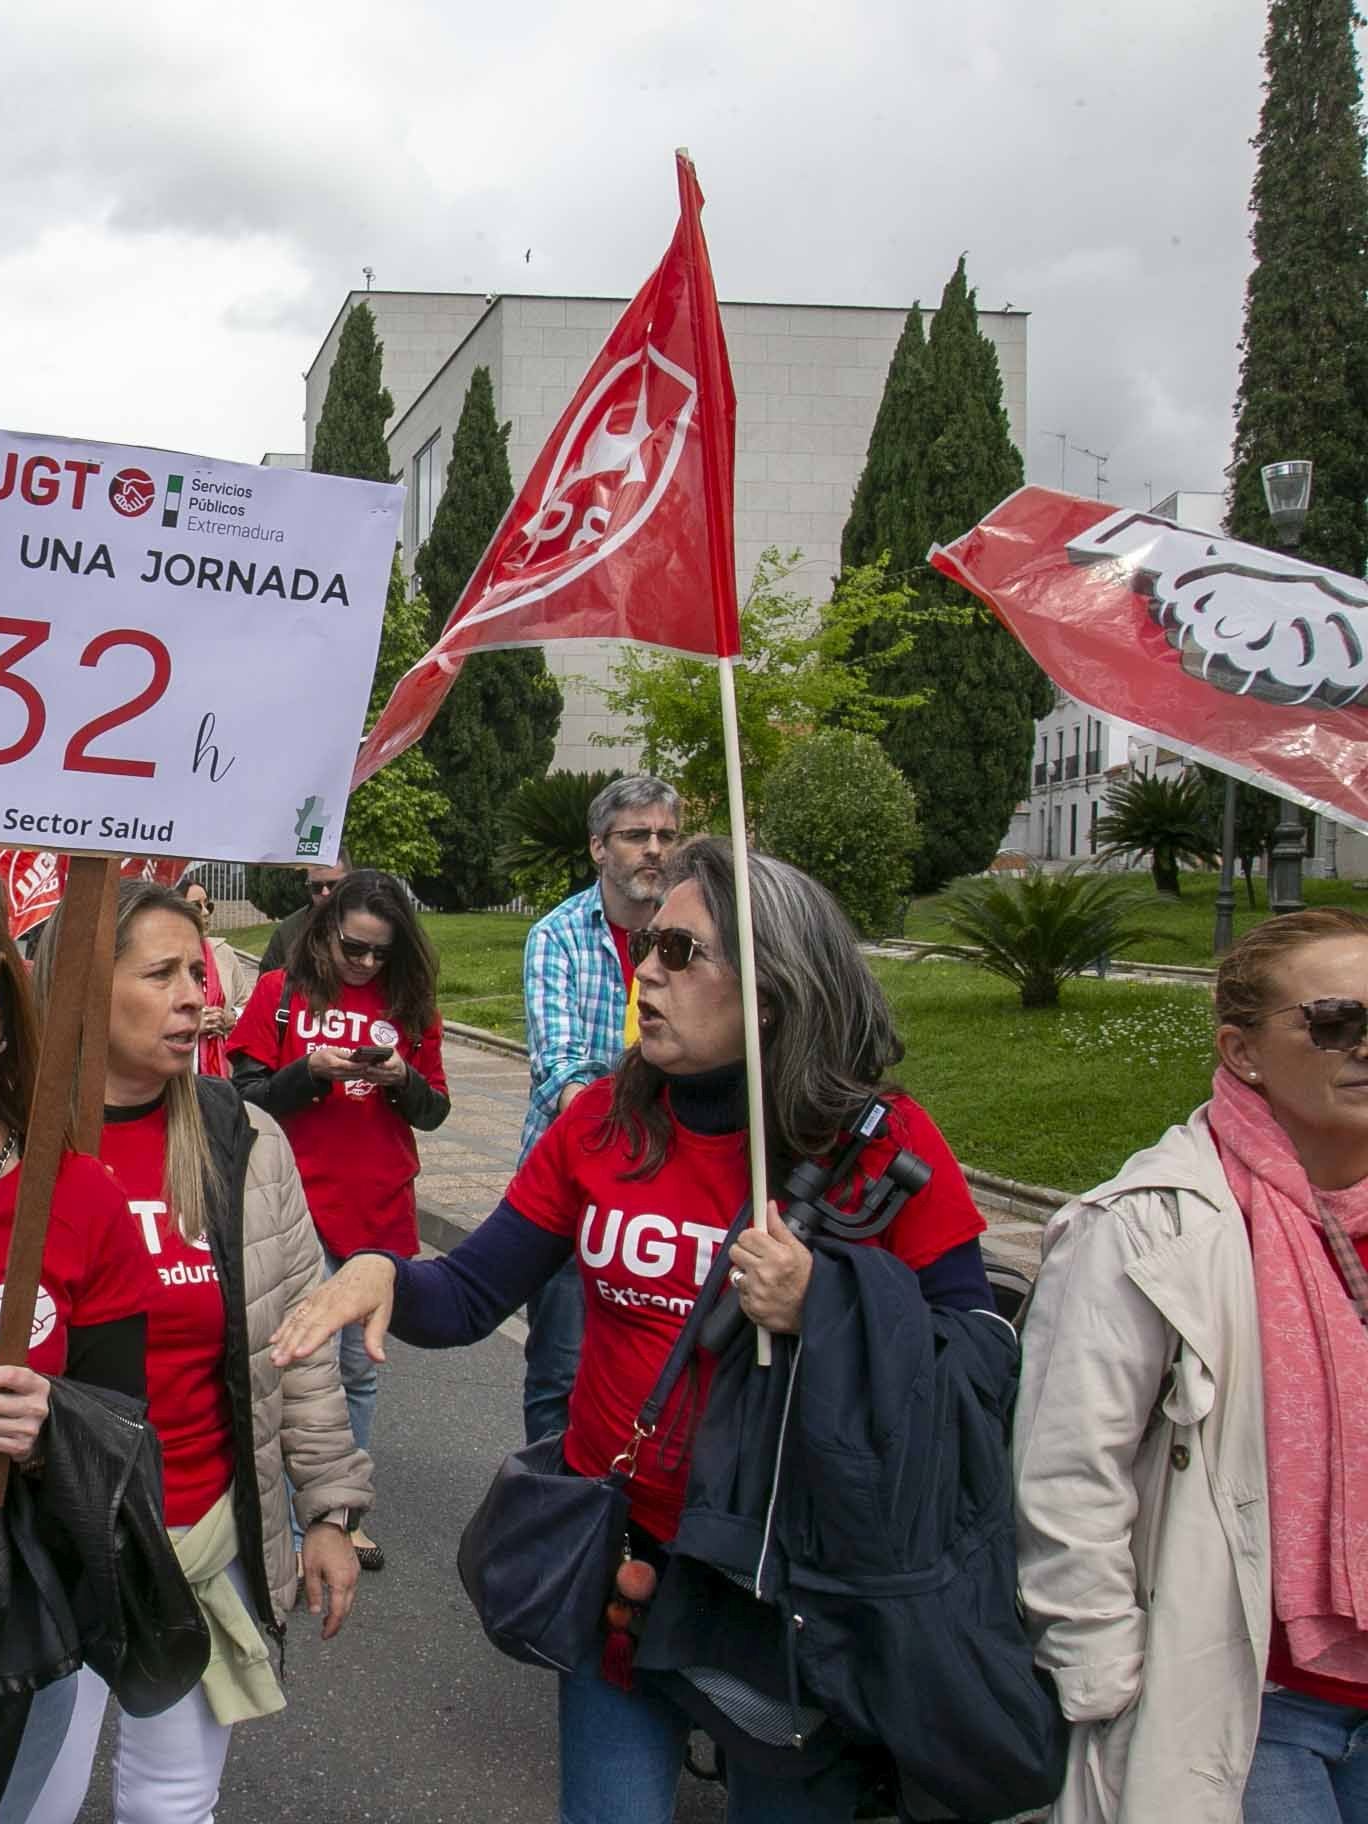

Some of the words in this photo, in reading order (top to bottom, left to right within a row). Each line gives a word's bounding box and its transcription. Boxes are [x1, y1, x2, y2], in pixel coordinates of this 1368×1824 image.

[192, 478, 253, 498] Servicios
[189, 498, 245, 516] Públicos
[188, 517, 285, 542] Extremadura
[20, 535, 116, 579] UNA
[140, 550, 350, 606] JORNADA
[192, 712, 235, 783] h
[3, 807, 93, 839] Sector
[99, 816, 174, 843] Salud
[298, 840, 320, 855] SES
[297, 1009, 368, 1042] UGT
[581, 1204, 728, 1286] UGT
[596, 1280, 696, 1317] Extrem
